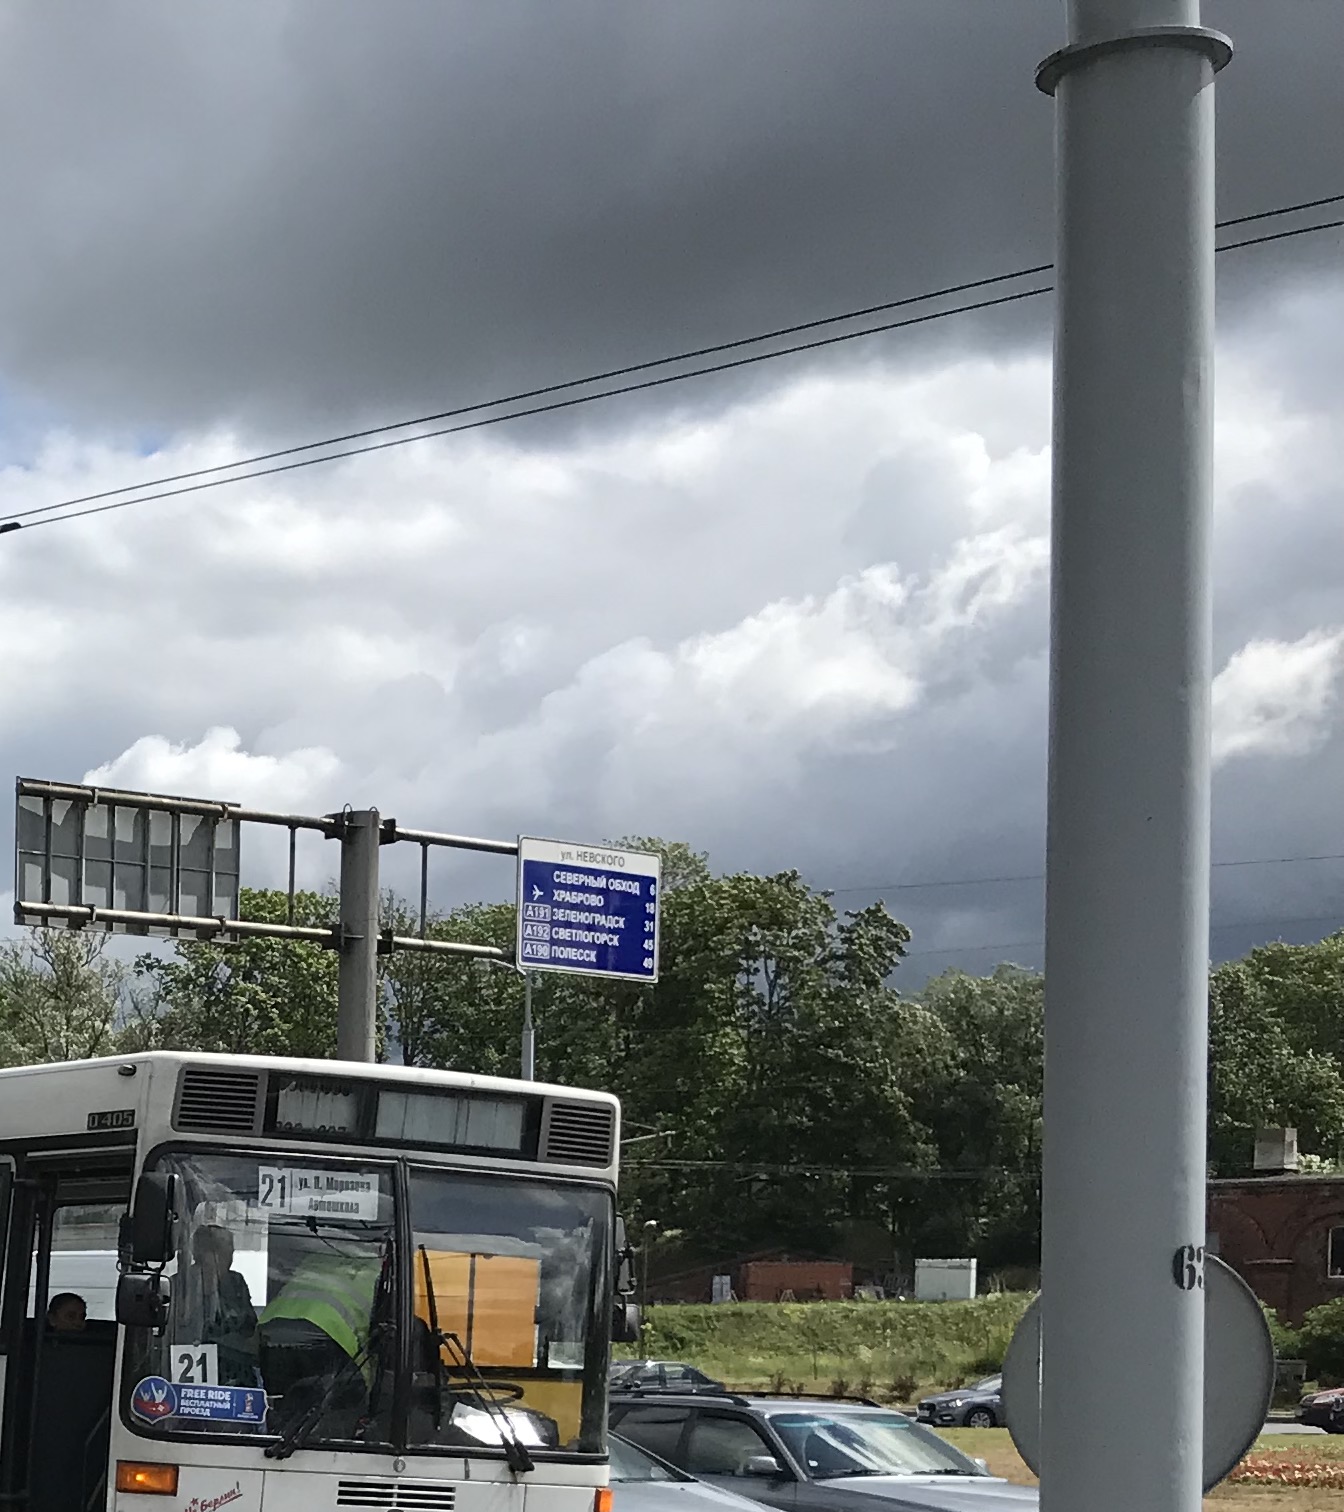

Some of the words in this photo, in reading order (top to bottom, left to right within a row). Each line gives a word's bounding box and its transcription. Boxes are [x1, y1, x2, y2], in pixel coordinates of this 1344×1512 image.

[560, 850, 574, 862] ул.
[576, 851, 626, 868] НЕВСКОГО
[552, 870, 607, 890] СЕВЕРНЫЙ
[608, 878, 641, 897] ОБХОД
[649, 884, 656, 896] 6
[552, 889, 604, 907] ХРАБРОВО
[645, 902, 655, 914] 18
[552, 908, 626, 929] ЗЕЛЕНОГРАДСК
[644, 920, 654, 932] 31
[551, 927, 620, 947] СВЕТЛОГОРСК
[643, 938, 654, 951] 45
[551, 946, 597, 962] ПОЛЕССК
[642, 957, 654, 969] 49
[101, 1111, 133, 1126] 405
[261, 1173, 287, 1208] 21
[178, 1352, 208, 1383] 21
[180, 1388, 207, 1399] FREE
[207, 1389, 232, 1401] RIDE
[180, 1399, 231, 1410] БЕСПЛАТНЫЙ
[179, 1407, 211, 1417] ПРОЕЗД
